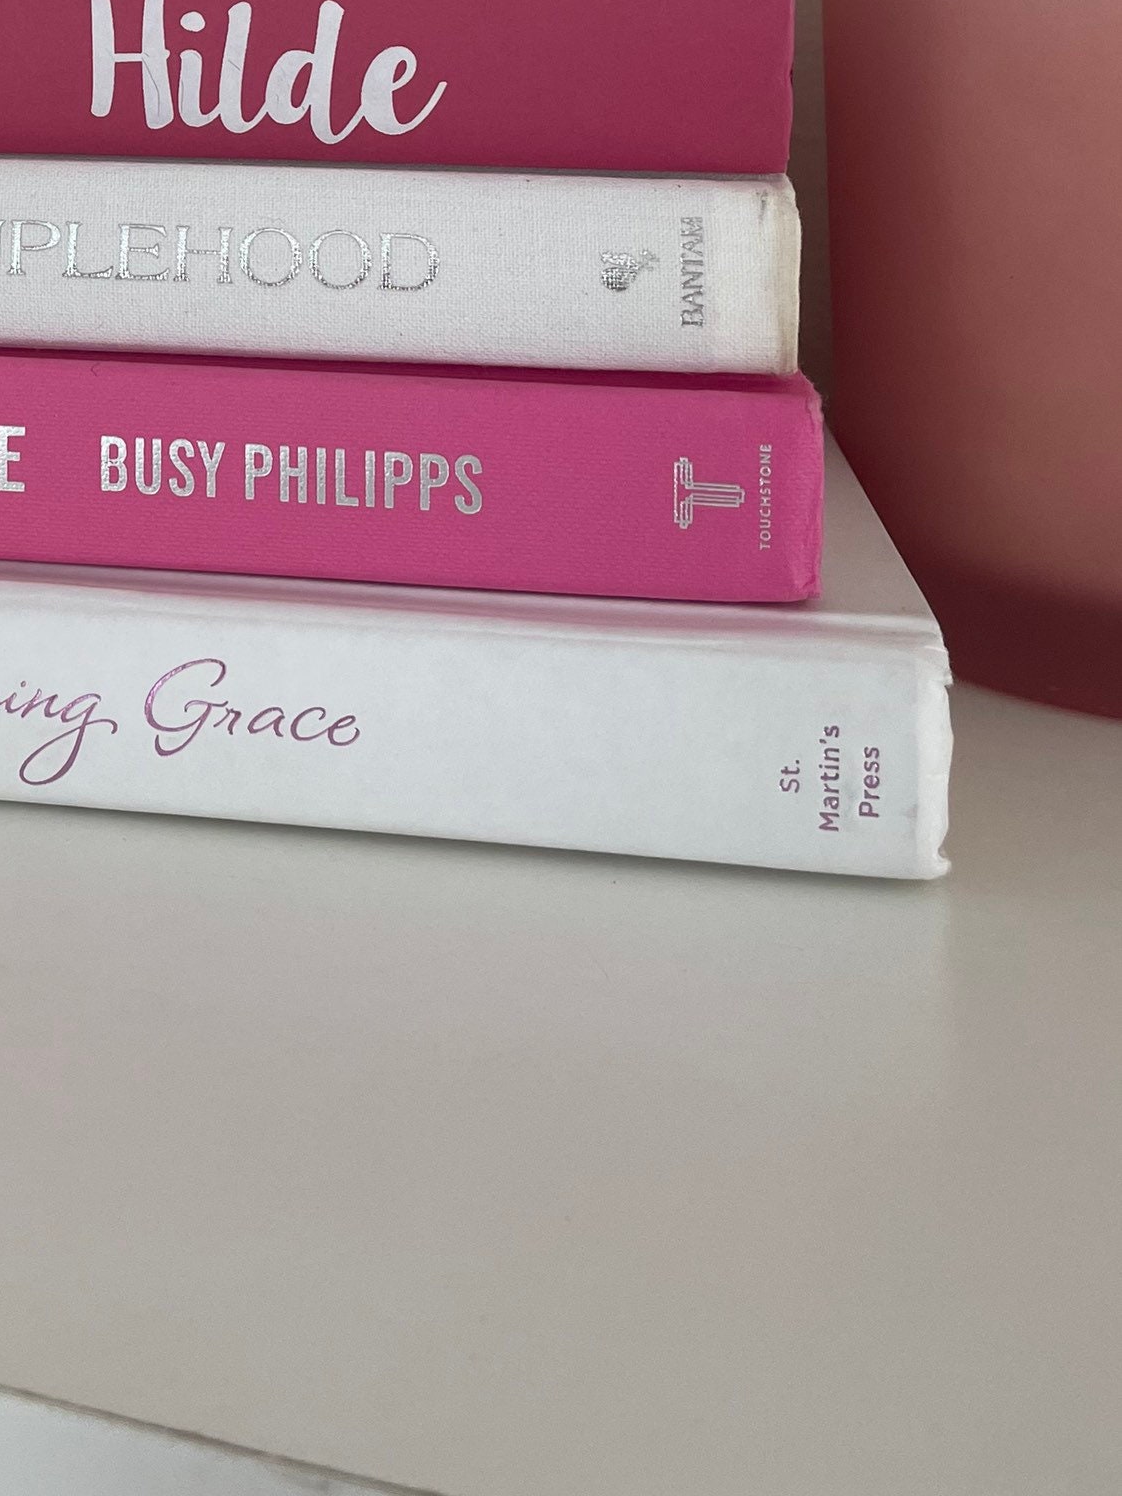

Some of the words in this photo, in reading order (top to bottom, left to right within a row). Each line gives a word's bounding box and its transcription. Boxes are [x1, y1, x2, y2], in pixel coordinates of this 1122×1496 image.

[680, 216, 705, 328] BANTAM
[100, 435, 226, 498] BUSY
[244, 443, 484, 515] PHILIPPS
[759, 443, 773, 551] TOUCHSTONE
[143, 657, 362, 757] Grace
[779, 759, 800, 794] St.
[818, 725, 840, 833] Martin's
[858, 746, 880, 819] Press
